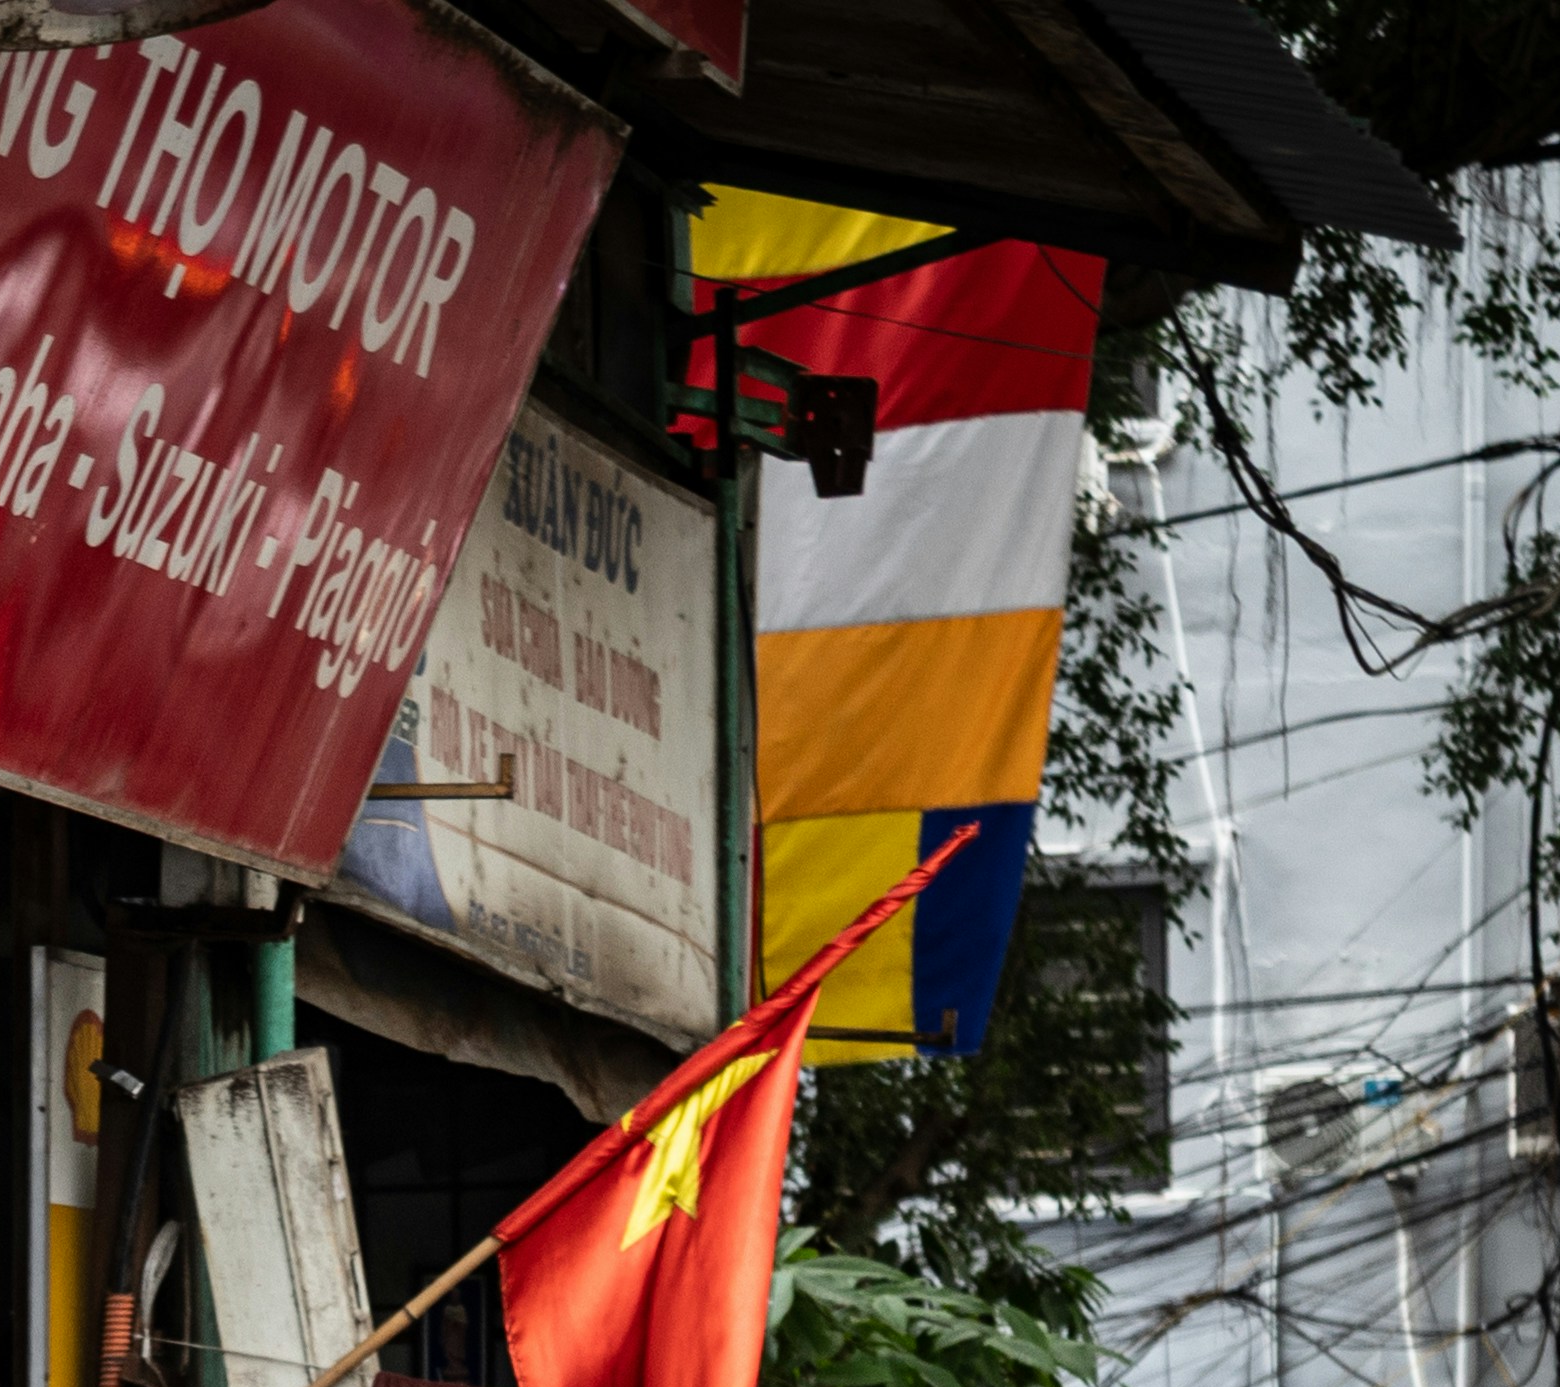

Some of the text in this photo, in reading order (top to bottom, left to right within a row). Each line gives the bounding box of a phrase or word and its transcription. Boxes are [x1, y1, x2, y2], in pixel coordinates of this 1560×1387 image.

[231, 110, 477, 378] MOTOR
[86, 383, 283, 597] Suzuki
[268, 466, 438, 698] Piaggio
